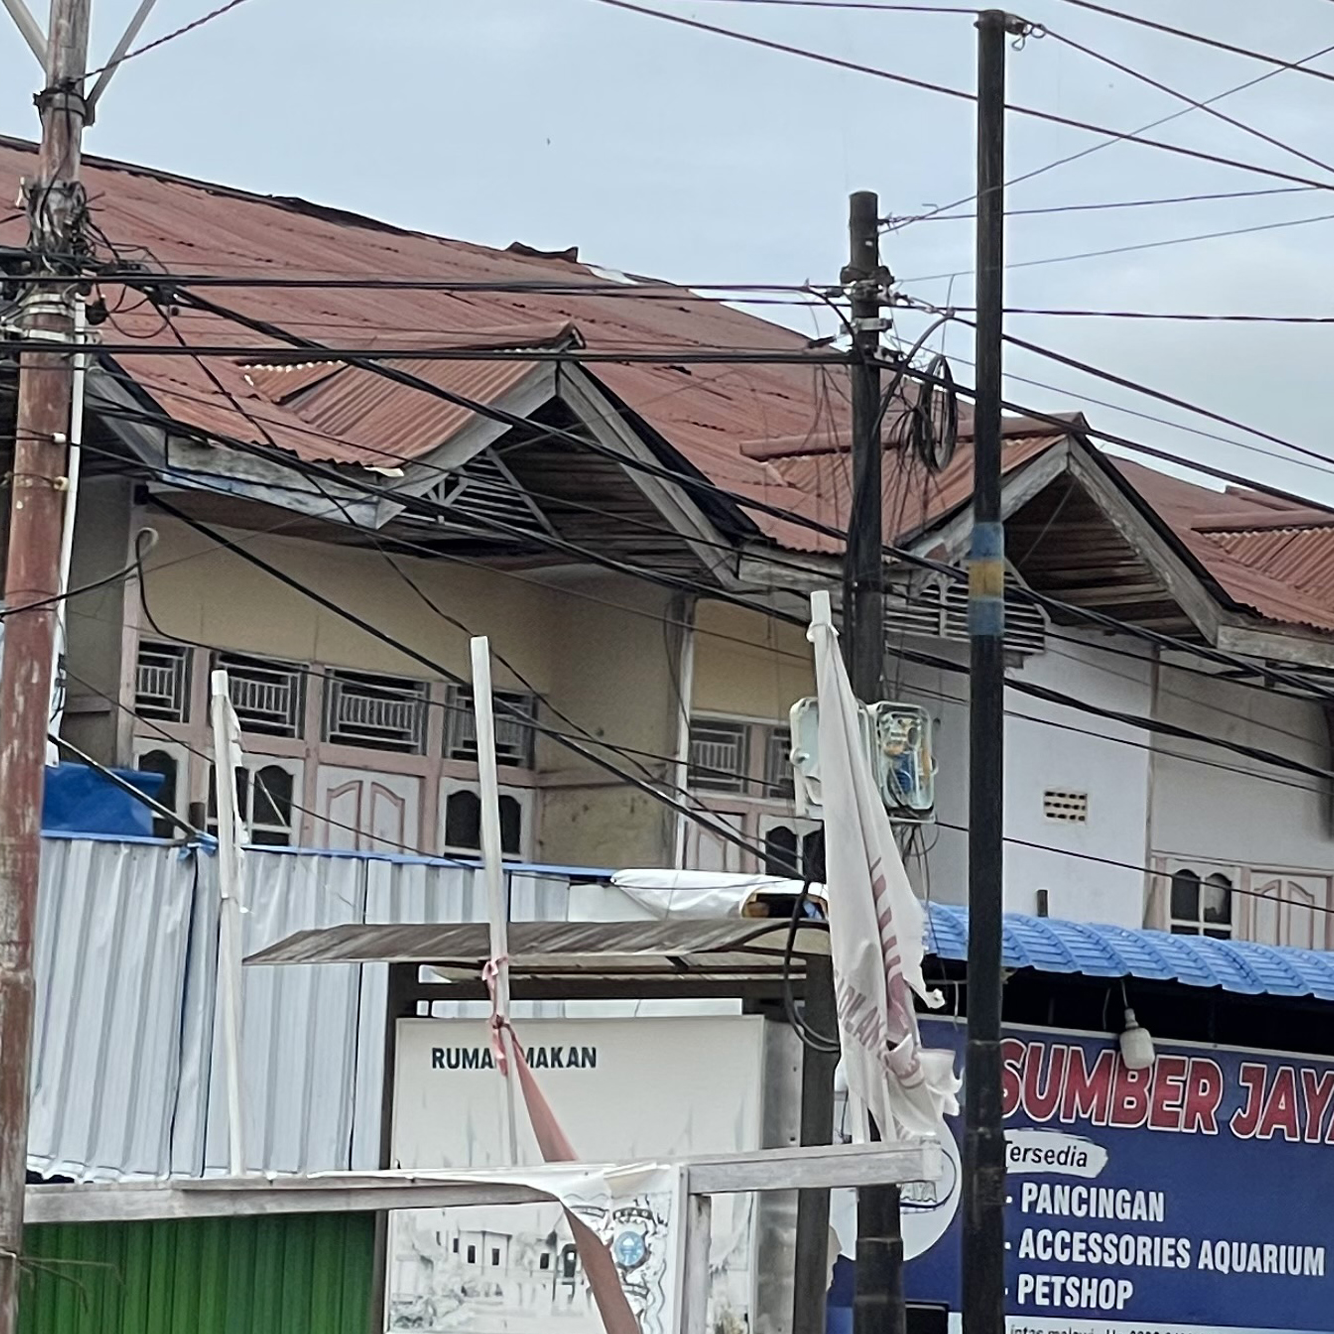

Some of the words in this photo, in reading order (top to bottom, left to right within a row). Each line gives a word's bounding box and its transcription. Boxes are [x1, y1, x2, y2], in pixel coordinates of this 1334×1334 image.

[432, 1047, 497, 1069] RUMA
[1000, 1038, 1224, 1135] SUMBER
[1021, 1181, 1166, 1222] PANCINGAN
[1018, 1228, 1191, 1269] ACCESSORIES
[1198, 1239, 1326, 1276] AQUARIUM
[1017, 1273, 1134, 1310] PETSHOP
